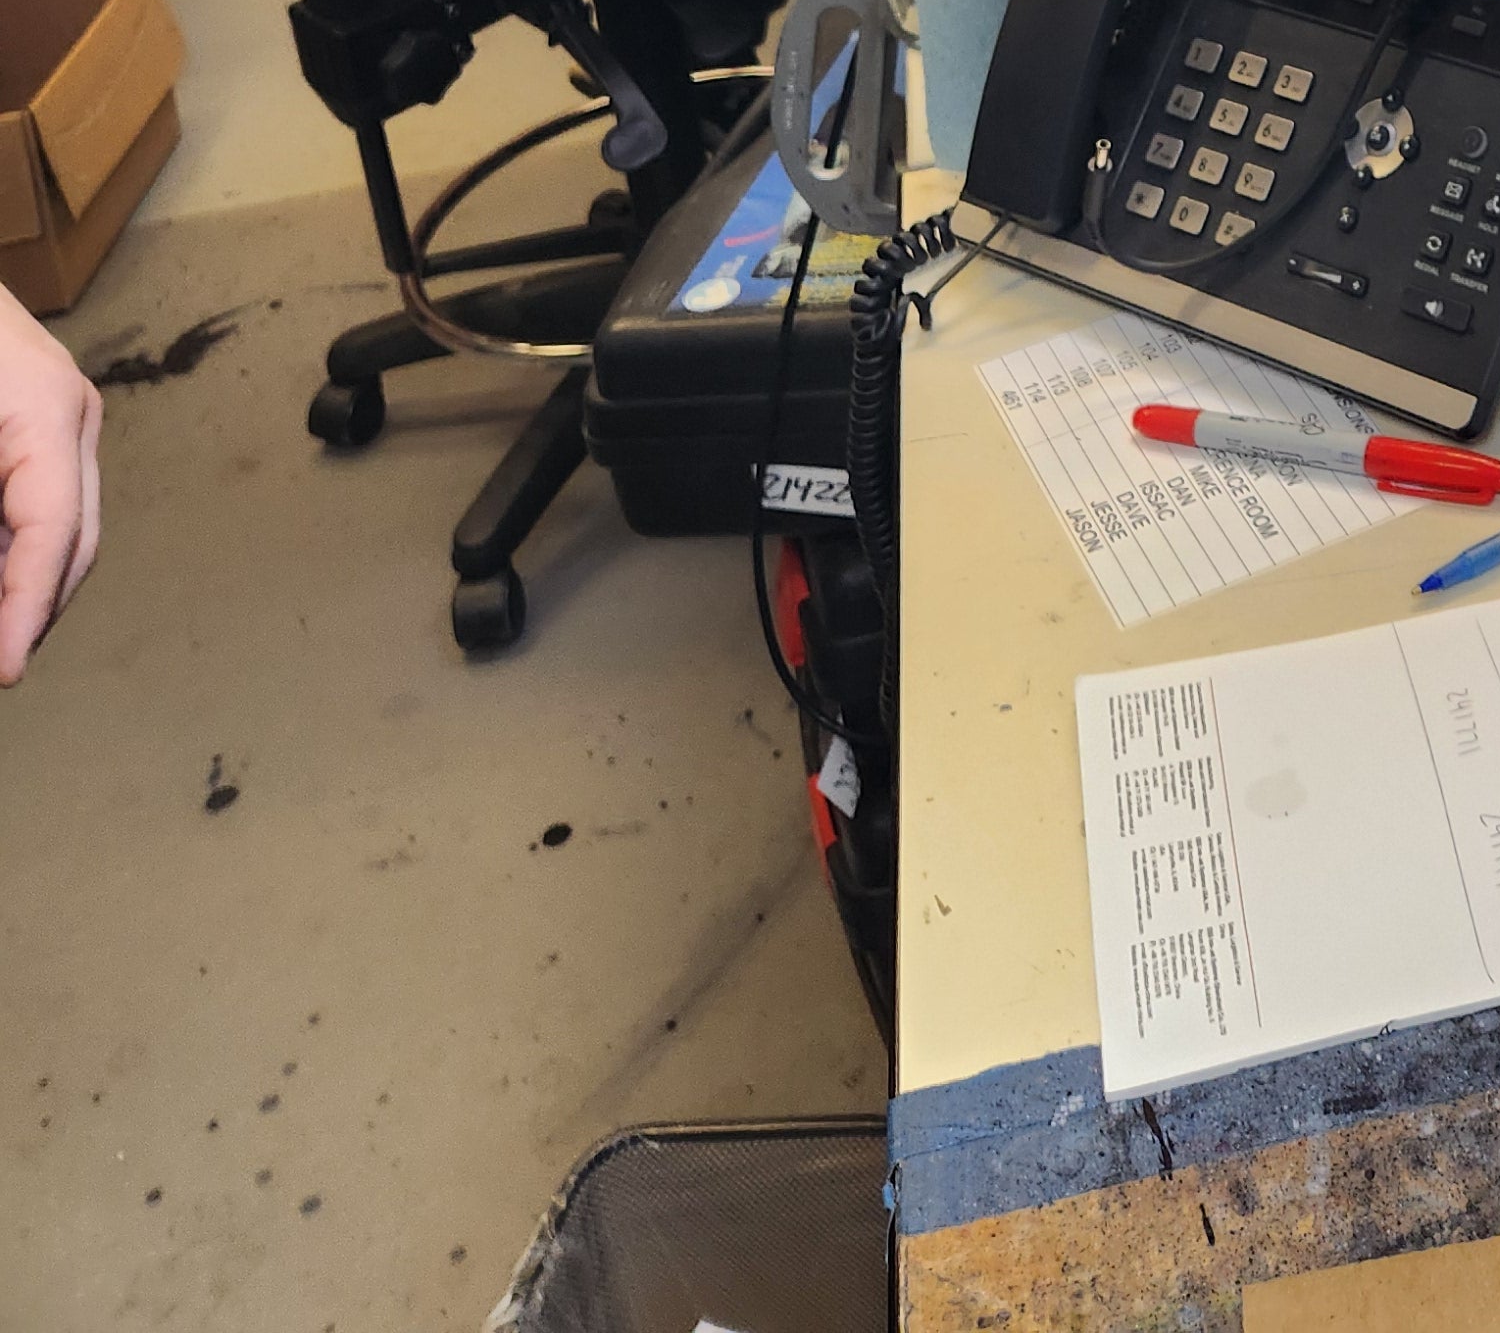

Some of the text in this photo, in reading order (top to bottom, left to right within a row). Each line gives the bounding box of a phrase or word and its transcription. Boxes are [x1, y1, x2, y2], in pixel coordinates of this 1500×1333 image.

[1237, 60, 1247, 75] 2
[1281, 75, 1291, 88] 3
[1219, 109, 1228, 122] 5
[1263, 124, 1272, 137] 6
[1153, 141, 1163, 154] 7
[1198, 158, 1208, 172] 8
[1179, 207, 1188, 222] 0
[1166, 474, 1195, 509] DAN
[1189, 463, 1220, 502] MIKE
[1115, 489, 1150, 532] DAVE
[1138, 478, 1174, 524] ISSAC
[1064, 503, 1103, 554] JASON
[1088, 495, 1127, 544] JESSE
[1239, 493, 1276, 542] ROOM
